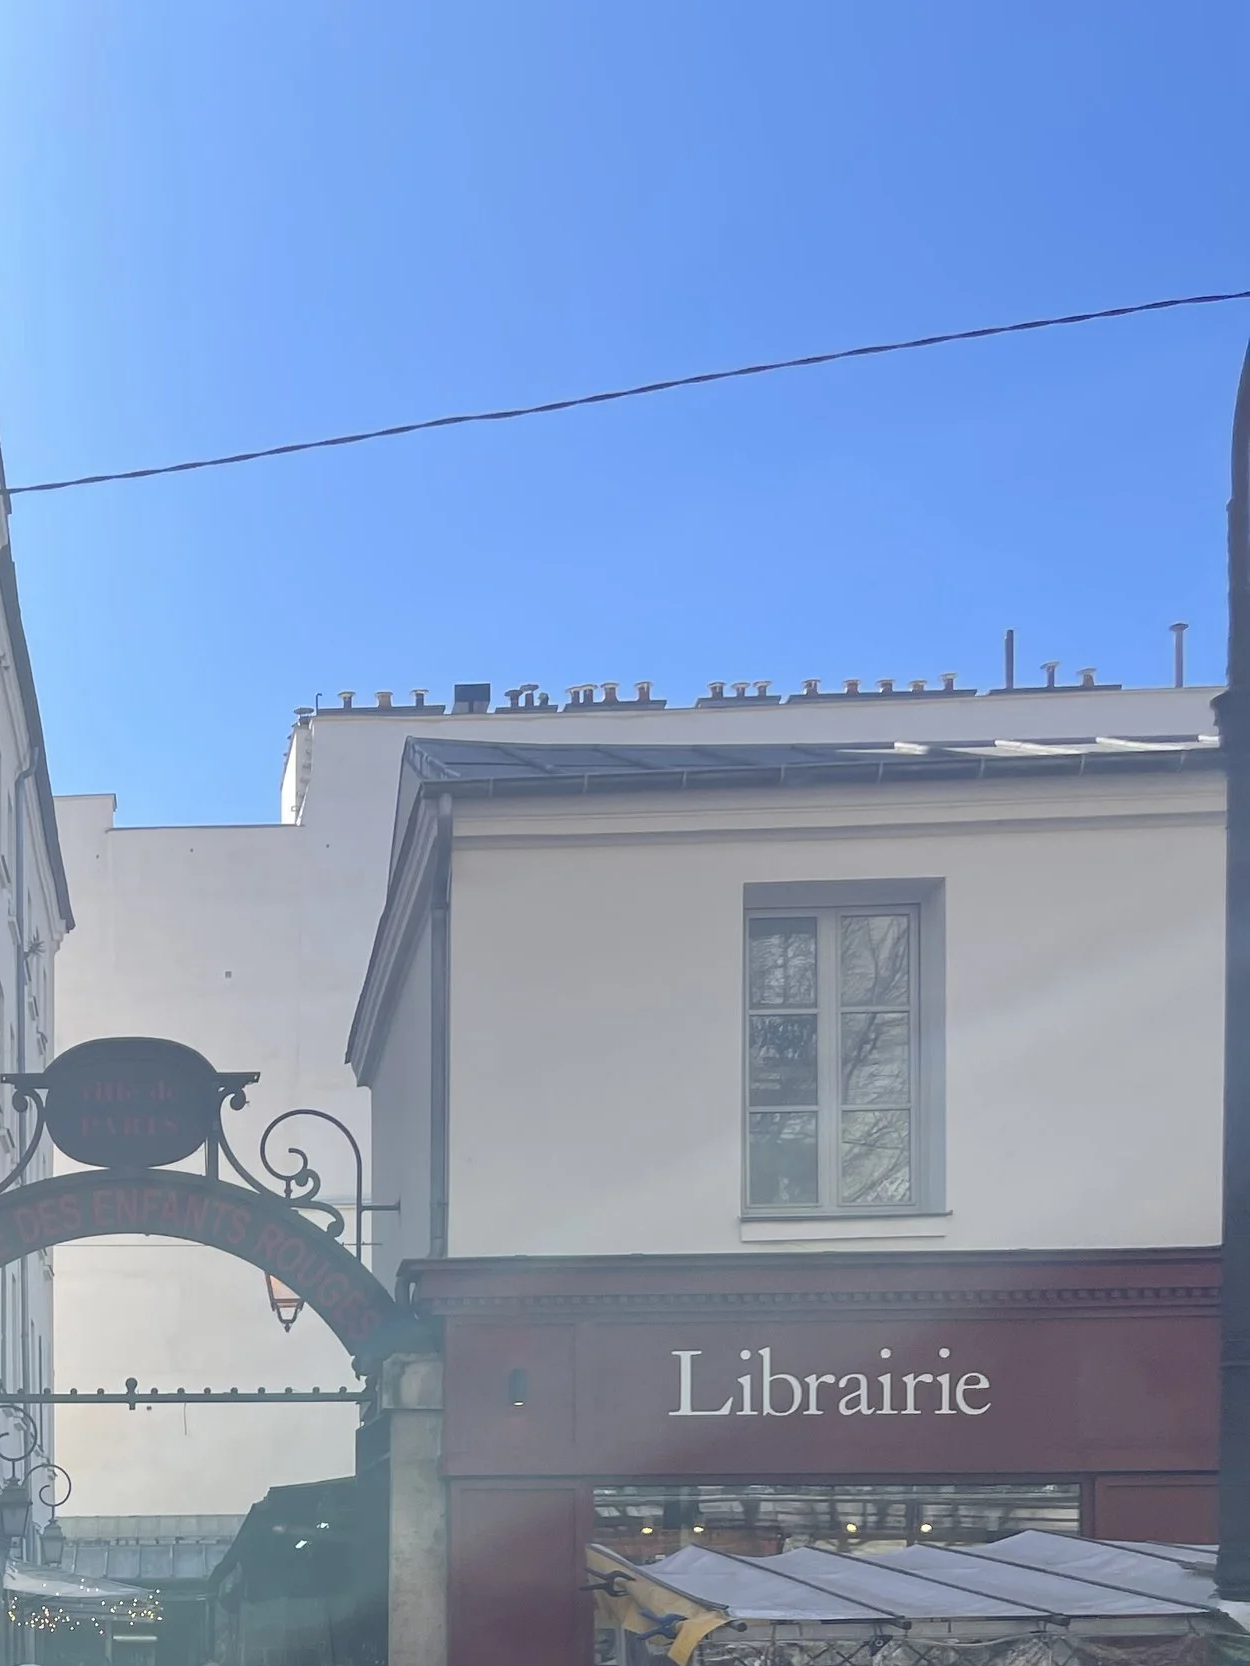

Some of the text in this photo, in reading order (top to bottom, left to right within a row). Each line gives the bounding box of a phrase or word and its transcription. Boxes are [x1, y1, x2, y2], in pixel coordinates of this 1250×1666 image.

[81, 1115, 181, 1140] PARIS
[14, 1194, 81, 1243] DES
[90, 1187, 253, 1245] ENFANTS
[253, 1220, 381, 1341] ROUGES
[667, 1346, 993, 1419] Librairie
